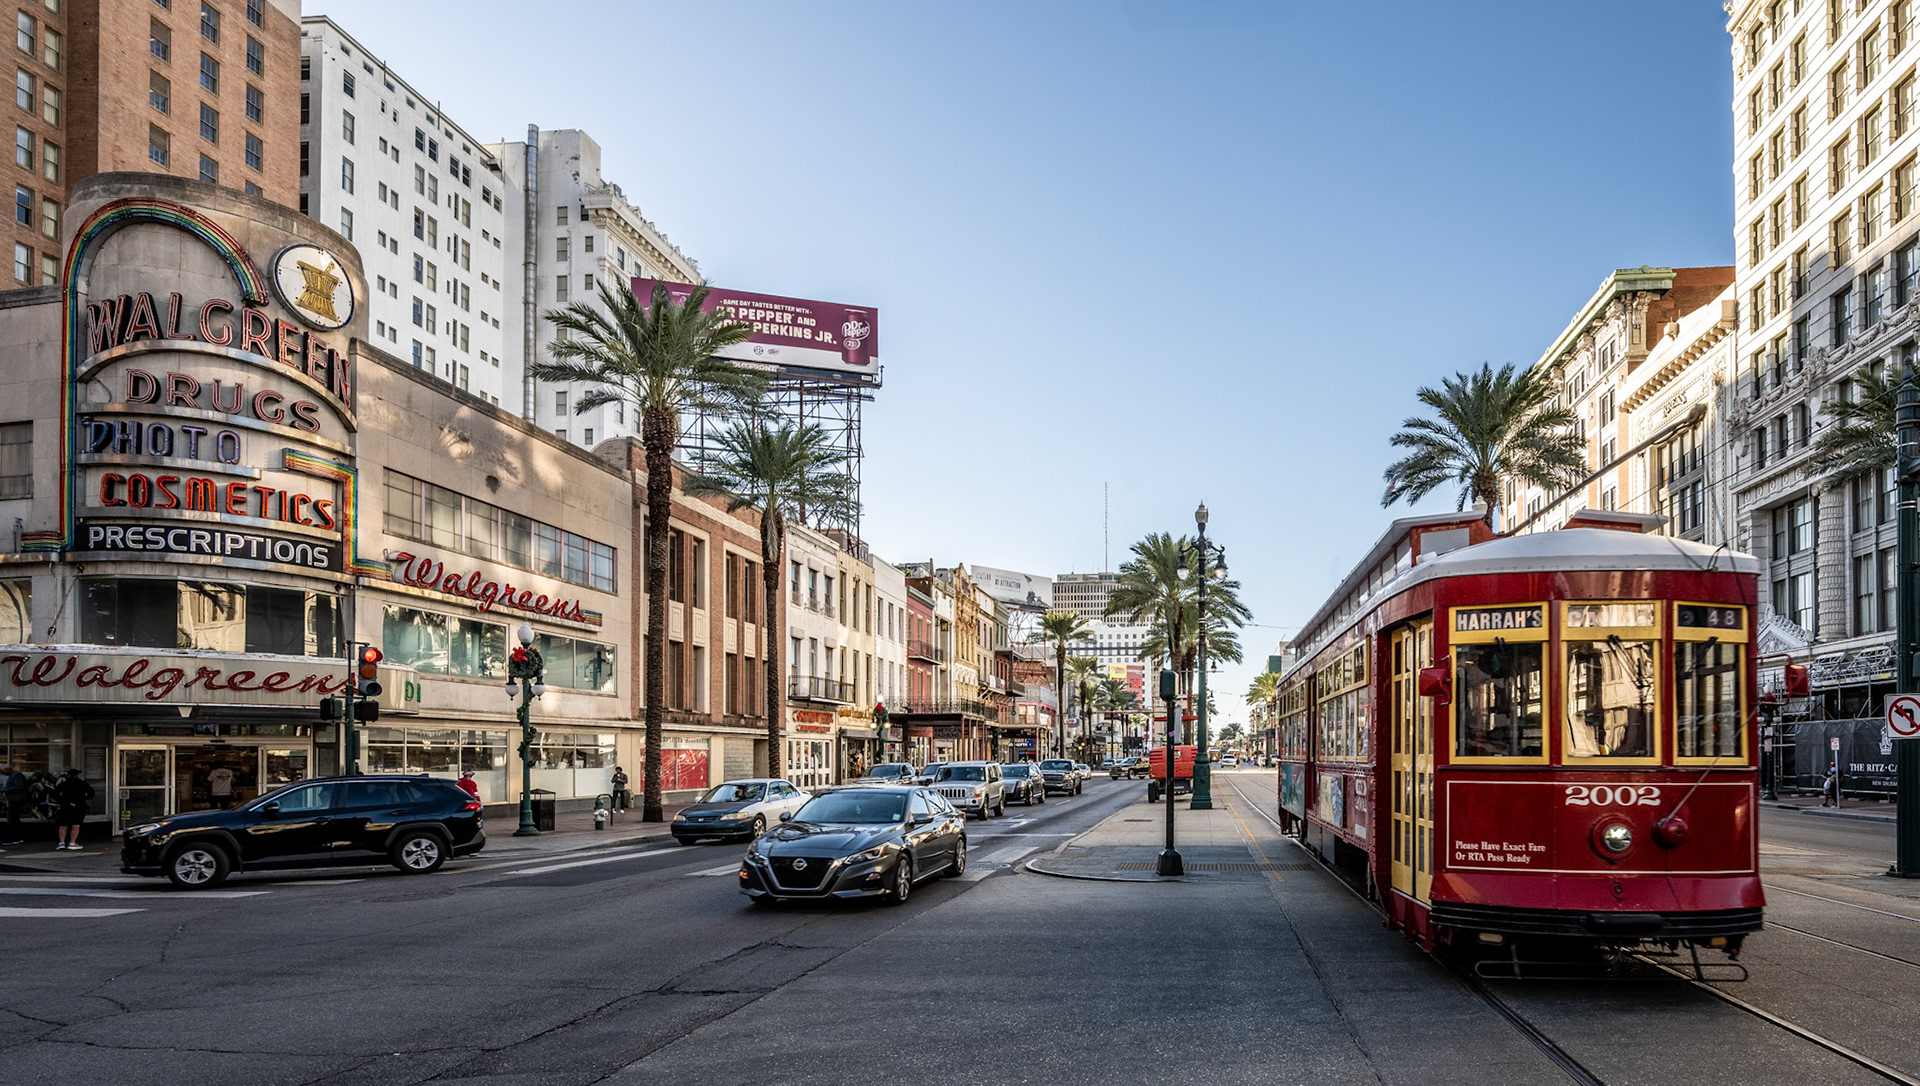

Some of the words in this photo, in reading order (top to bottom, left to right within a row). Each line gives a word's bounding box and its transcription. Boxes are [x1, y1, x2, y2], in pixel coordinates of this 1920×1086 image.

[739, 307, 792, 324] PEPPER
[797, 316, 816, 327] AND
[752, 301, 773, 309] TASTES
[774, 303, 795, 311] BETTER
[795, 305, 810, 314] WITH
[753, 322, 813, 340] PERKINS
[814, 330, 837, 345] JR.
[86, 291, 352, 408] WALGREEN
[125, 368, 321, 433] DRUGS
[89, 420, 241, 464] PHOTO
[100, 472, 335, 530] COSMETICS
[88, 526, 329, 568] PRESCRIPTIONS
[392, 552, 586, 622] Walgreens
[1457, 609, 1542, 631] HARRAH'S
[1849, 764, 1865, 772] THE
[1564, 786, 1661, 807] 2002
[1455, 840, 1479, 850] Please
[1481, 841, 1500, 850] Have
[1502, 842, 1526, 851] Exact
[1528, 843, 1546, 852] Fare
[1455, 851, 1466, 860] Or
[1468, 852, 1485, 861] RTA
[1487, 853, 1505, 862] Pass
[1507, 853, 1531, 864] Ready
